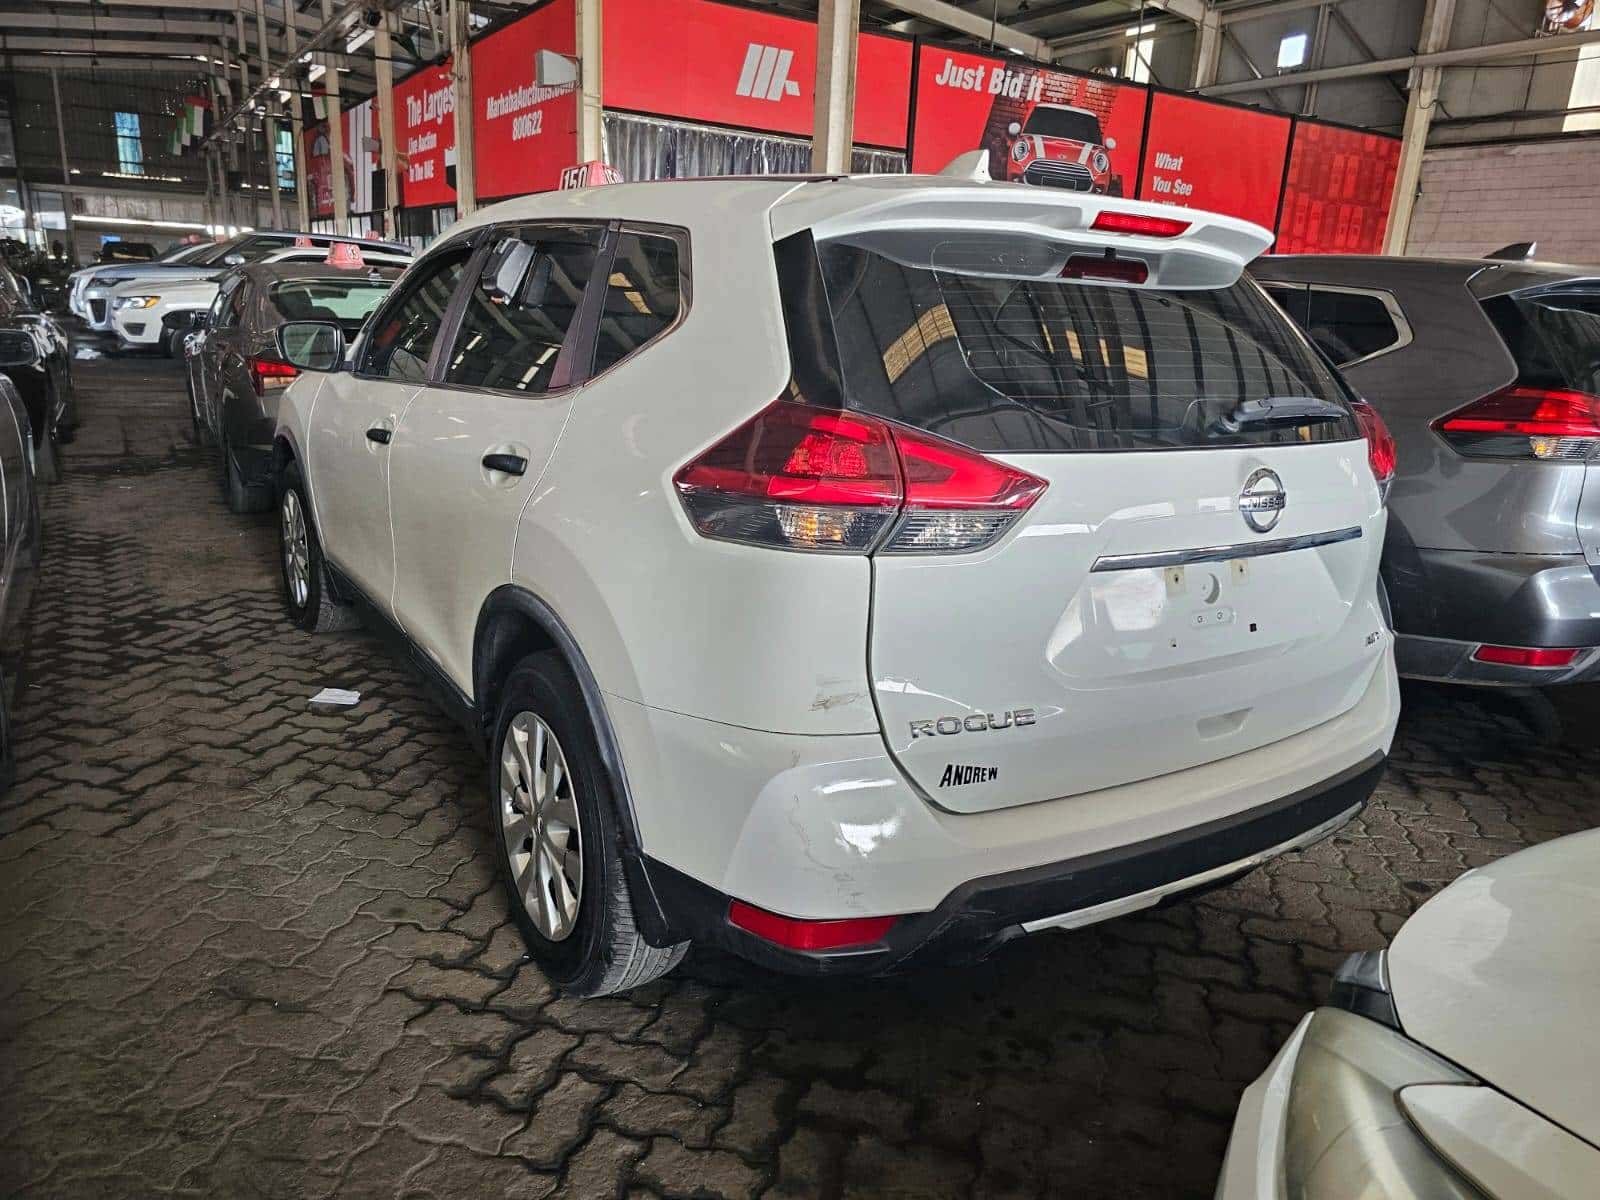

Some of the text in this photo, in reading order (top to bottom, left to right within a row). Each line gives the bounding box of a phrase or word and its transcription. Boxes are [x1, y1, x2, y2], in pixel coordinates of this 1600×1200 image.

[935, 57, 1044, 103] Just Bid It
[406, 84, 455, 128] The Larges
[512, 110, 543, 141] 800622
[1155, 152, 1184, 171] What
[563, 165, 588, 191] 150
[1152, 176, 1193, 196] You See
[909, 708, 1037, 739] ROGUE
[938, 764, 999, 788] ANDREW
